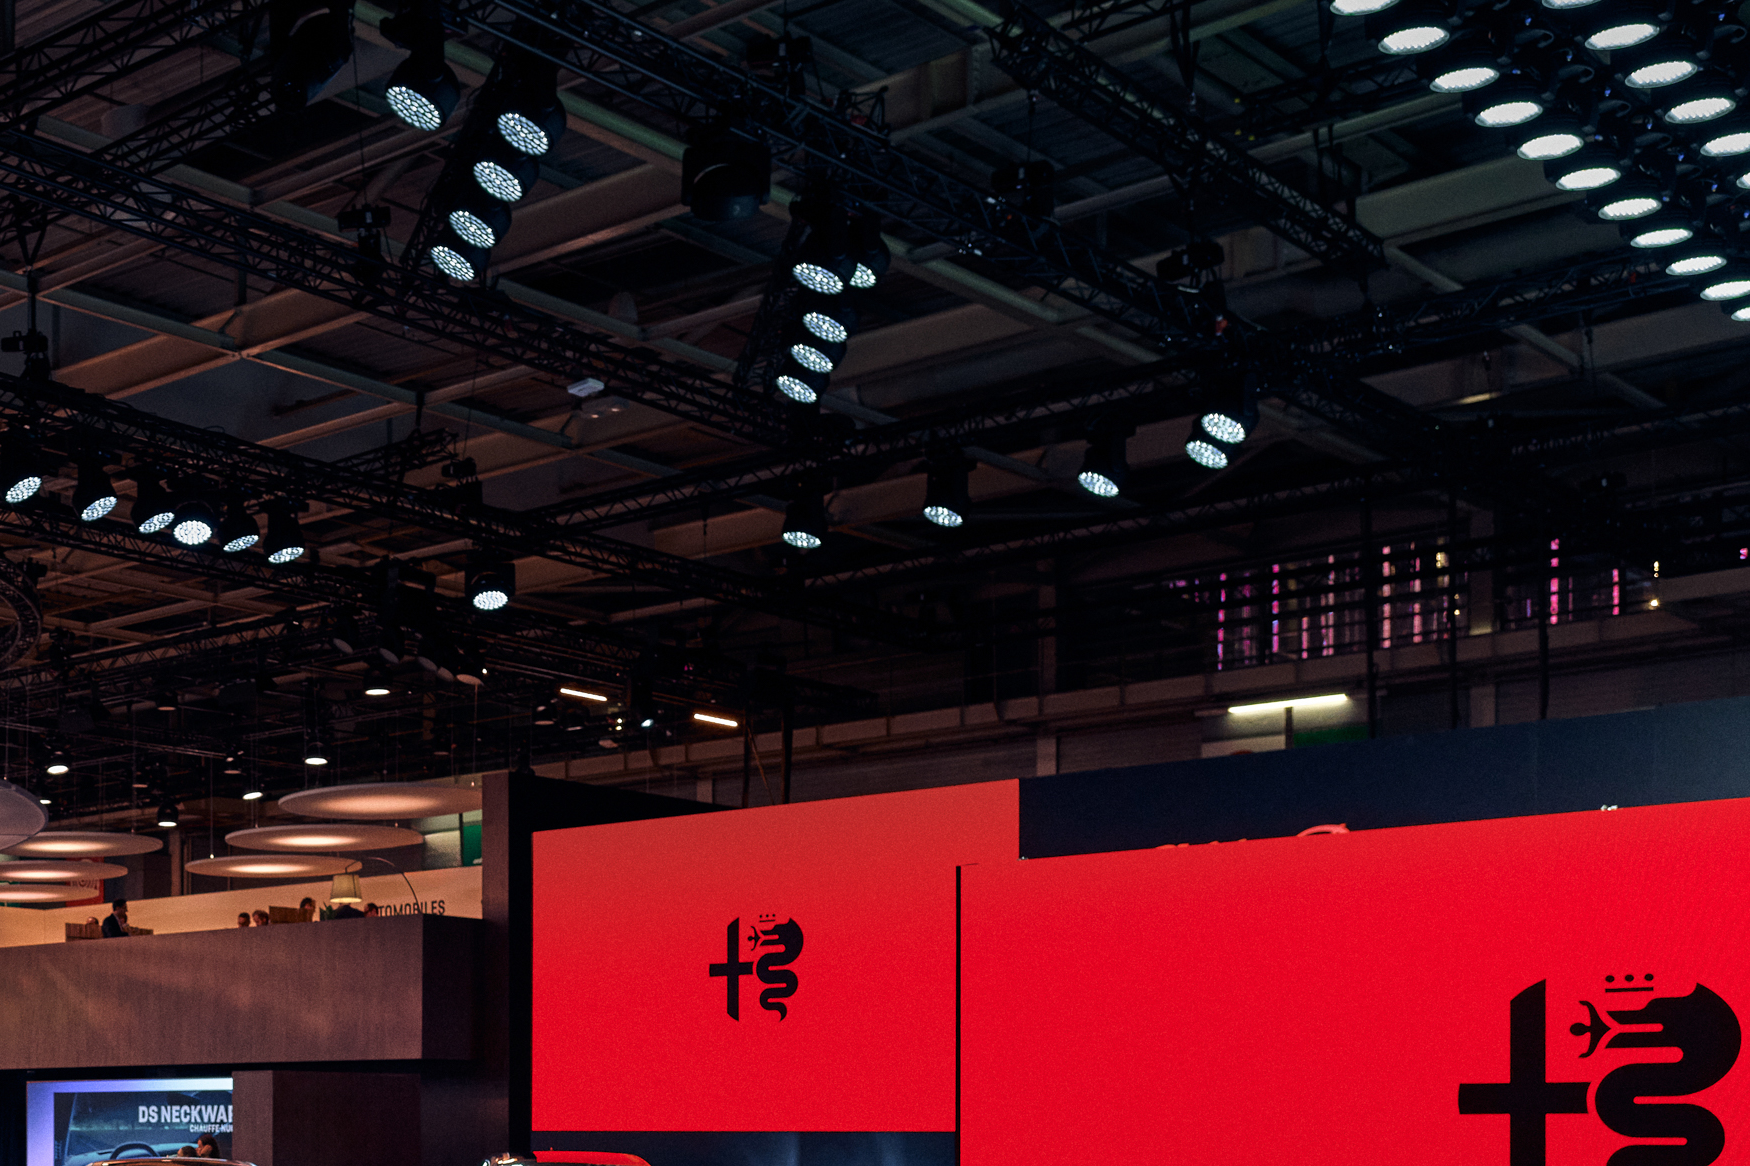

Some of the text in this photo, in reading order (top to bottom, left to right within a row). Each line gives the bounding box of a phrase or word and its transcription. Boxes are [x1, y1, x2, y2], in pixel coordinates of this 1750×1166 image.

[378, 900, 446, 917] TOMOBILES
[138, 1105, 159, 1123] DS
[189, 1124, 233, 1133] CHAUFFE-NU
